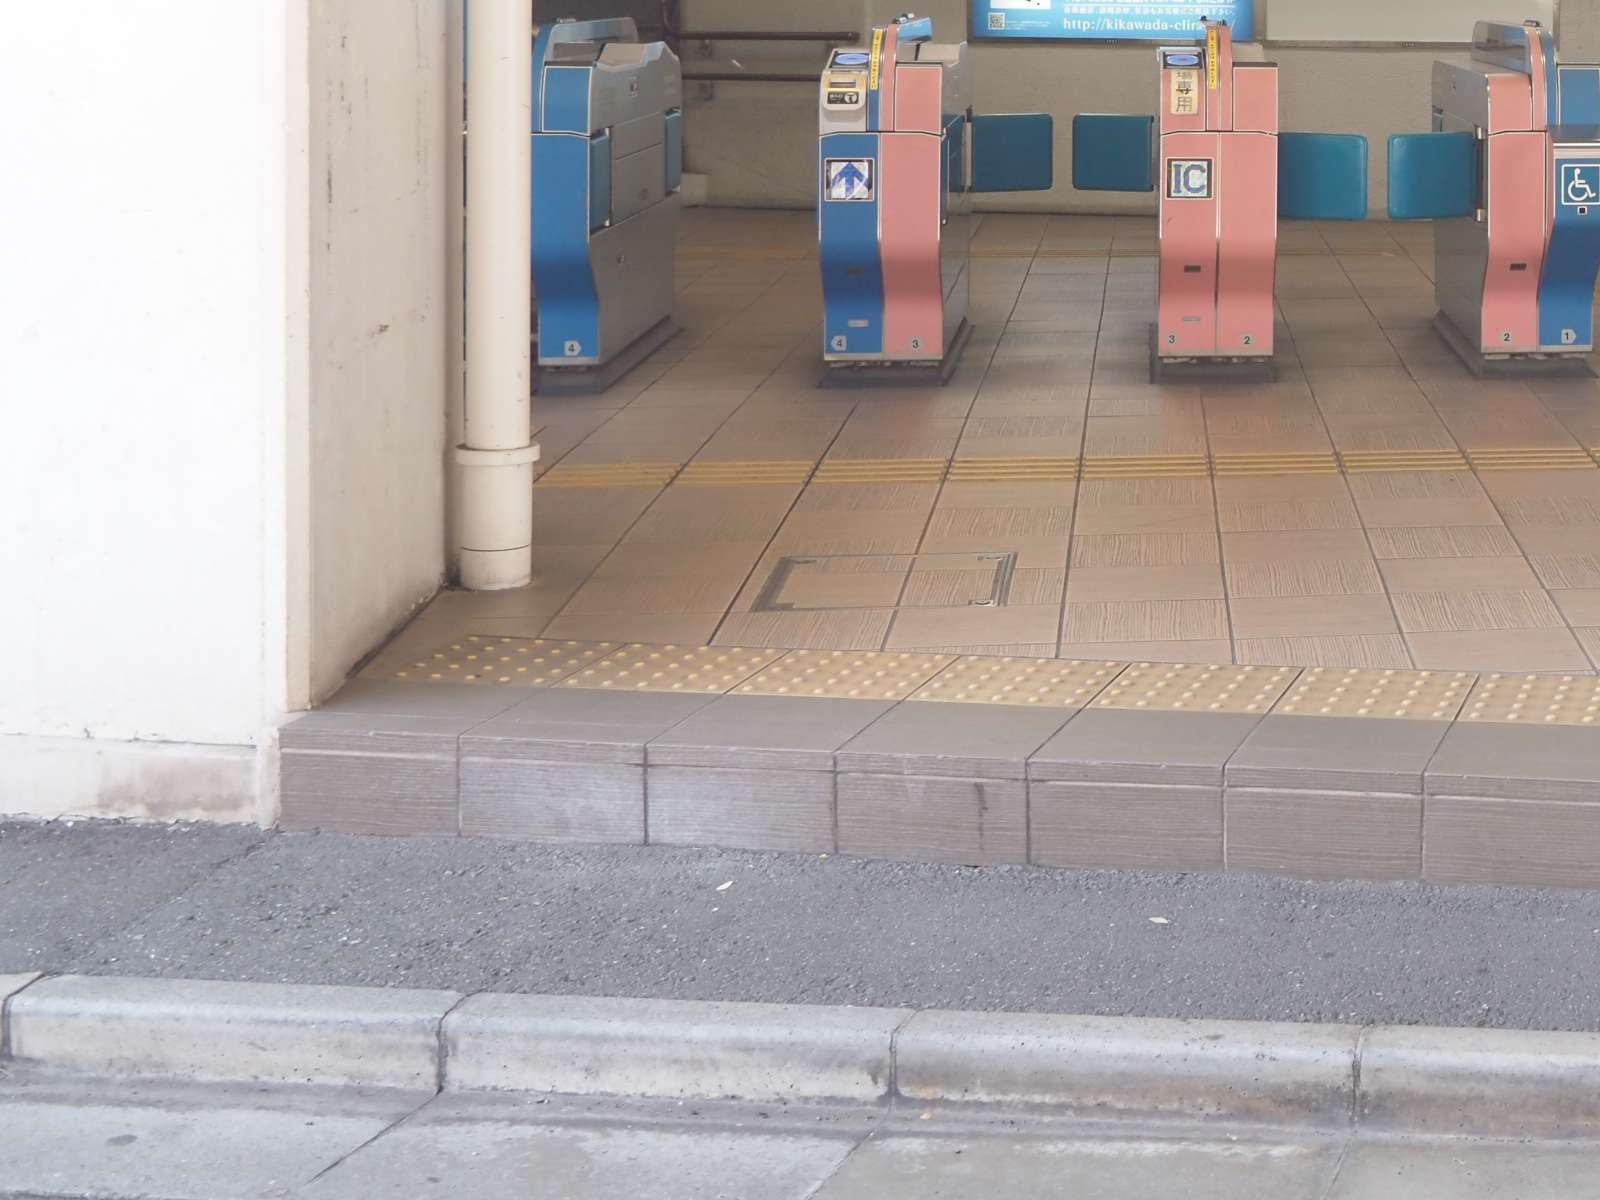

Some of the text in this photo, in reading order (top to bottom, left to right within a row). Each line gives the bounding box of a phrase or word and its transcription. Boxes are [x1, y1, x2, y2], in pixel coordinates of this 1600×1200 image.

[1176, 71, 1193, 112] 場専用
[1172, 163, 1206, 194] IC
[1168, 334, 1175, 344] 3
[1243, 335, 1251, 345] 2
[1503, 332, 1511, 342] 2
[1564, 332, 1569, 341] 1
[568, 343, 575, 353] 4
[836, 339, 843, 348] 4
[912, 340, 919, 348] 3
